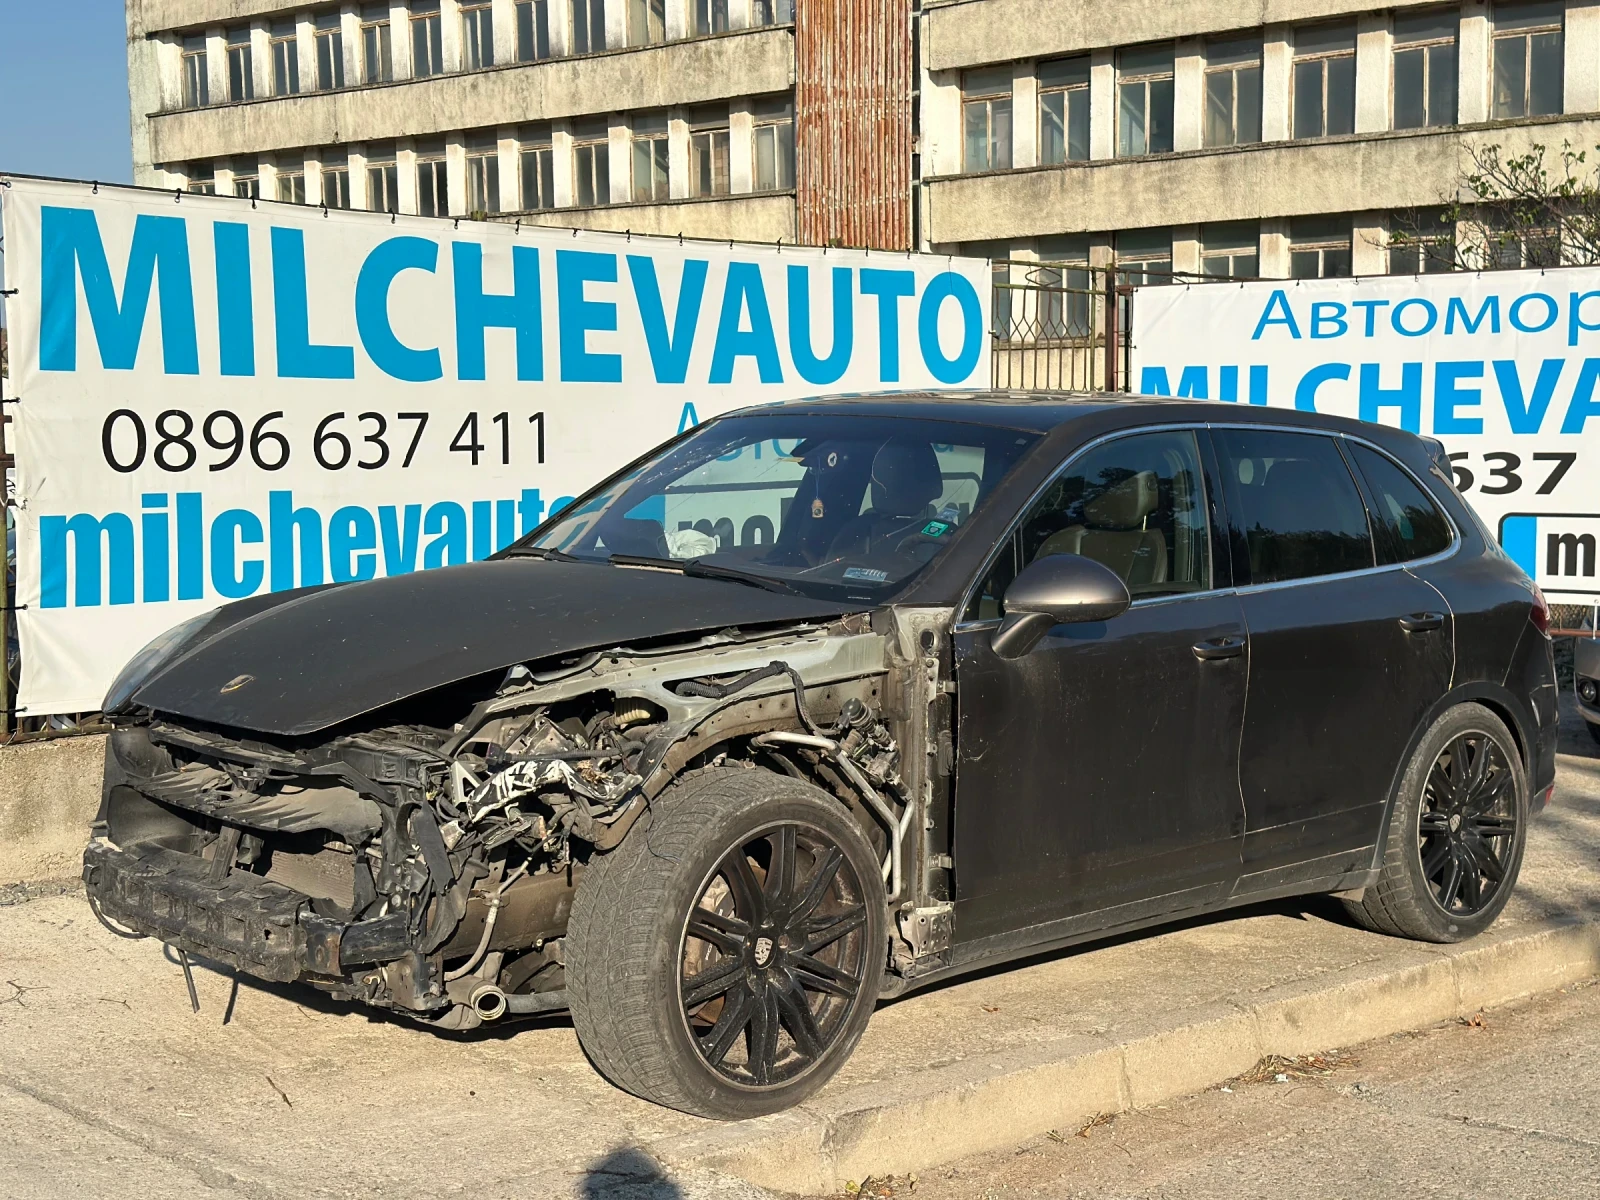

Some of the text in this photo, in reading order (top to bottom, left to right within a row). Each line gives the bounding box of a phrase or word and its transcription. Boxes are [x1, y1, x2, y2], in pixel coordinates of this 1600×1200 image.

[39, 205, 983, 385] MILCHEVAUTO
[101, 408, 547, 473] 0896 637 411
[39, 487, 577, 609] milchevaut
